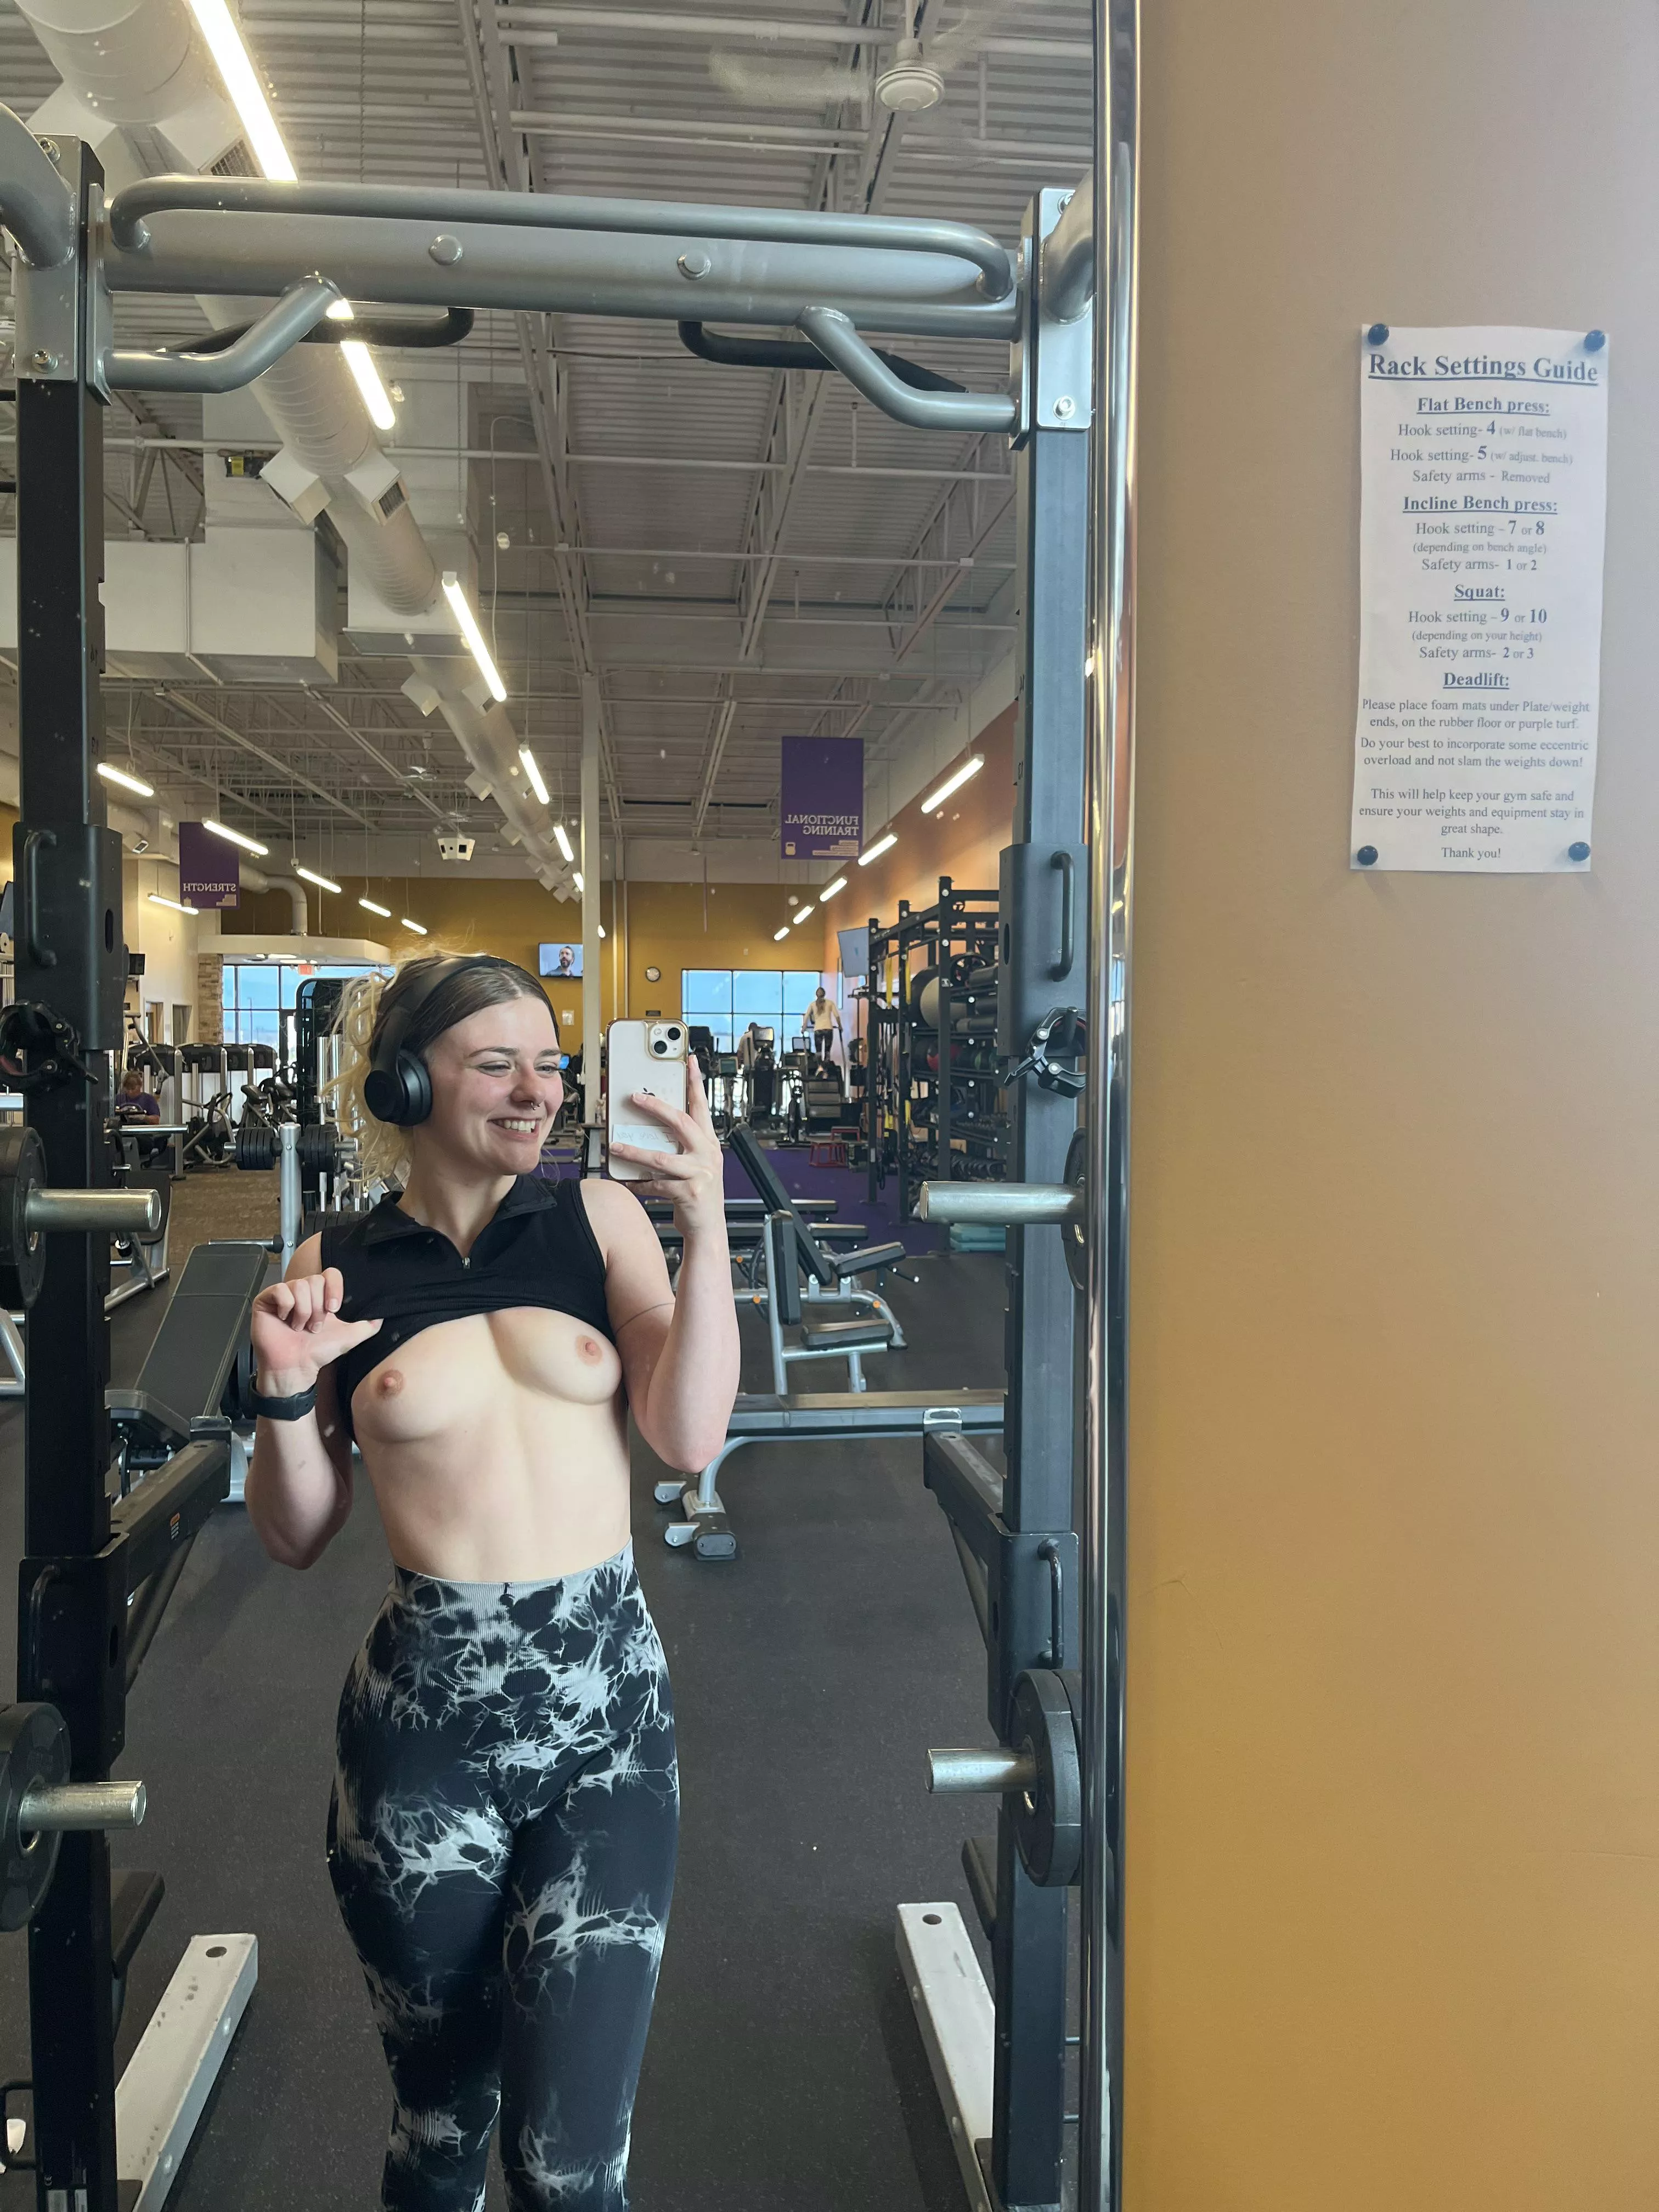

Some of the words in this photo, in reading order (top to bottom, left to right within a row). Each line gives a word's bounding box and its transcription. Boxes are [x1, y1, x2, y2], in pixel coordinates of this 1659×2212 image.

[1369, 353, 1426, 376] Rack
[1435, 356, 1526, 377] Settings
[1533, 358, 1598, 381] Guide
[1418, 398, 1449, 411] Flat
[1455, 397, 1502, 411] Bench
[1507, 400, 1549, 414] press:
[1398, 424, 1431, 436] Hook
[1436, 422, 1483, 438] setting-
[1487, 420, 1496, 435] 4
[1519, 427, 1533, 437] flat
[1536, 427, 1567, 439] bench)
[1390, 449, 1423, 461] Hook
[1428, 448, 1474, 463] setting-
[1477, 445, 1487, 460] 5
[1491, 451, 1506, 462] (w/
[1542, 453, 1573, 465] bench)
[1413, 470, 1452, 483] Safety
[1456, 472, 1486, 481] arms
[1502, 471, 1549, 483] Removed
[1403, 496, 1457, 510] Incline
[1463, 496, 1509, 510] Bench
[1514, 499, 1557, 512] press:
[1416, 523, 1449, 534] Hook
[1454, 522, 1495, 537] setting
[1508, 520, 1517, 534] 7
[1521, 527, 1533, 535] or
[1536, 521, 1545, 535] 8
[1413, 542, 1469, 554] (depending
[1487, 543, 1514, 552] bench
[1517, 544, 1547, 555] angle)
[1421, 558, 1462, 572] Safety
[1465, 560, 1499, 569] arms-
[1507, 559, 1511, 569] 1
[1516, 562, 1527, 570] or
[1531, 560, 1537, 570] 2
[1454, 584, 1505, 600] Squat:
[1408, 611, 1443, 623] Hook
[1446, 611, 1487, 625] setting
[1500, 607, 1509, 622] 9
[1514, 614, 1526, 623] or
[1530, 609, 1547, 624] 10
[1412, 631, 1468, 642] (depending
[1486, 633, 1508, 642] your
[1510, 631, 1543, 642] height)
[1419, 647, 1458, 660] Safety
[1463, 648, 1496, 658] arms-
[1503, 647, 1509, 658] 2
[1513, 651, 1523, 659] or
[1527, 648, 1534, 659] 3
[1443, 672, 1509, 687] Deadlift:
[1362, 699, 1396, 710] Please
[1399, 701, 1427, 711] place
[1431, 701, 1458, 710] foam
[1490, 702, 1519, 712] under
[1522, 702, 1589, 714] Plate/weight
[1370, 717, 1398, 729] ends,
[1402, 719, 1415, 727] on
[1419, 717, 1436, 727] the
[1439, 718, 1474, 728] rubber
[1477, 718, 1501, 728] floor
[1519, 718, 1553, 731] purple
[1556, 719, 1579, 729] turf.
[1361, 737, 1375, 749] Do
[1379, 740, 1404, 750] your
[1408, 738, 1430, 749] best
[1434, 740, 1443, 749] to
[1447, 739, 1505, 752] incorporate
[1509, 741, 1537, 750] some
[1540, 740, 1588, 751] eccentric
[1364, 755, 1411, 766] overload
[1415, 755, 1434, 766] and
[1438, 757, 1454, 766] not
[1458, 756, 1482, 766] slam
[1485, 757, 1501, 766] the
[1504, 757, 1545, 769] weights
[1549, 758, 1583, 768] down!
[1371, 788, 1395, 799] This
[1398, 789, 1419, 799] will
[1423, 789, 1446, 802] help
[1449, 790, 1473, 803] keep
[1476, 792, 1500, 803] your
[1504, 793, 1527, 803] gym
[1531, 791, 1551, 801] safe
[1555, 791, 1574, 802] and
[1359, 808, 1393, 816] ensure
[1397, 808, 1422, 817] your
[1425, 807, 1465, 819] weights
[1469, 807, 1488, 817] and
[1491, 808, 1547, 820] equipment
[1550, 809, 1570, 820] stay
[1574, 808, 1584, 819] in
[1441, 825, 1467, 836] great
[1470, 824, 1503, 836] shape.
[1442, 848, 1475, 859] Thank
[1479, 849, 1501, 859] you!
